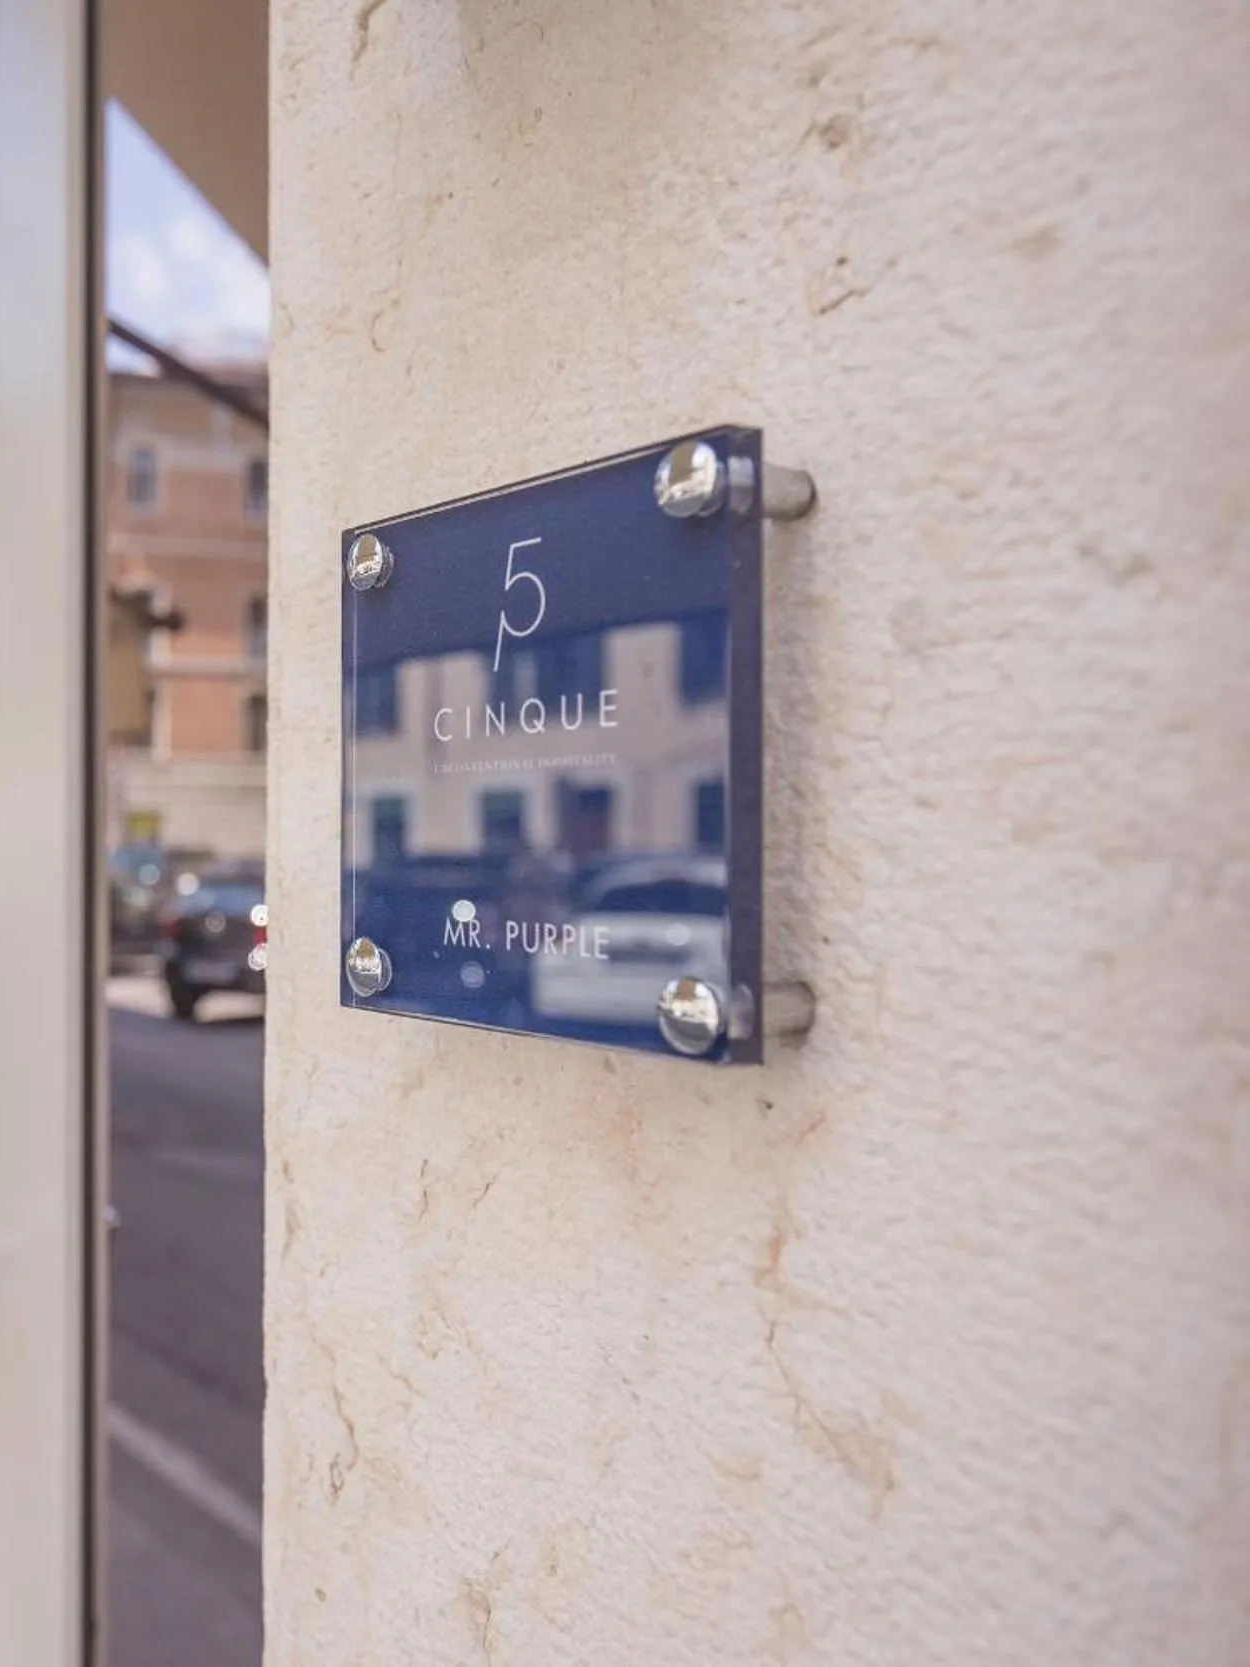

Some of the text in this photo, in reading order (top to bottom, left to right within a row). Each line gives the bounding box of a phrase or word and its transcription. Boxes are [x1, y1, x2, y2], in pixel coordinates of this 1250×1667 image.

[434, 689, 618, 742] CINQUE
[443, 916, 610, 959] MR. PURPLE
